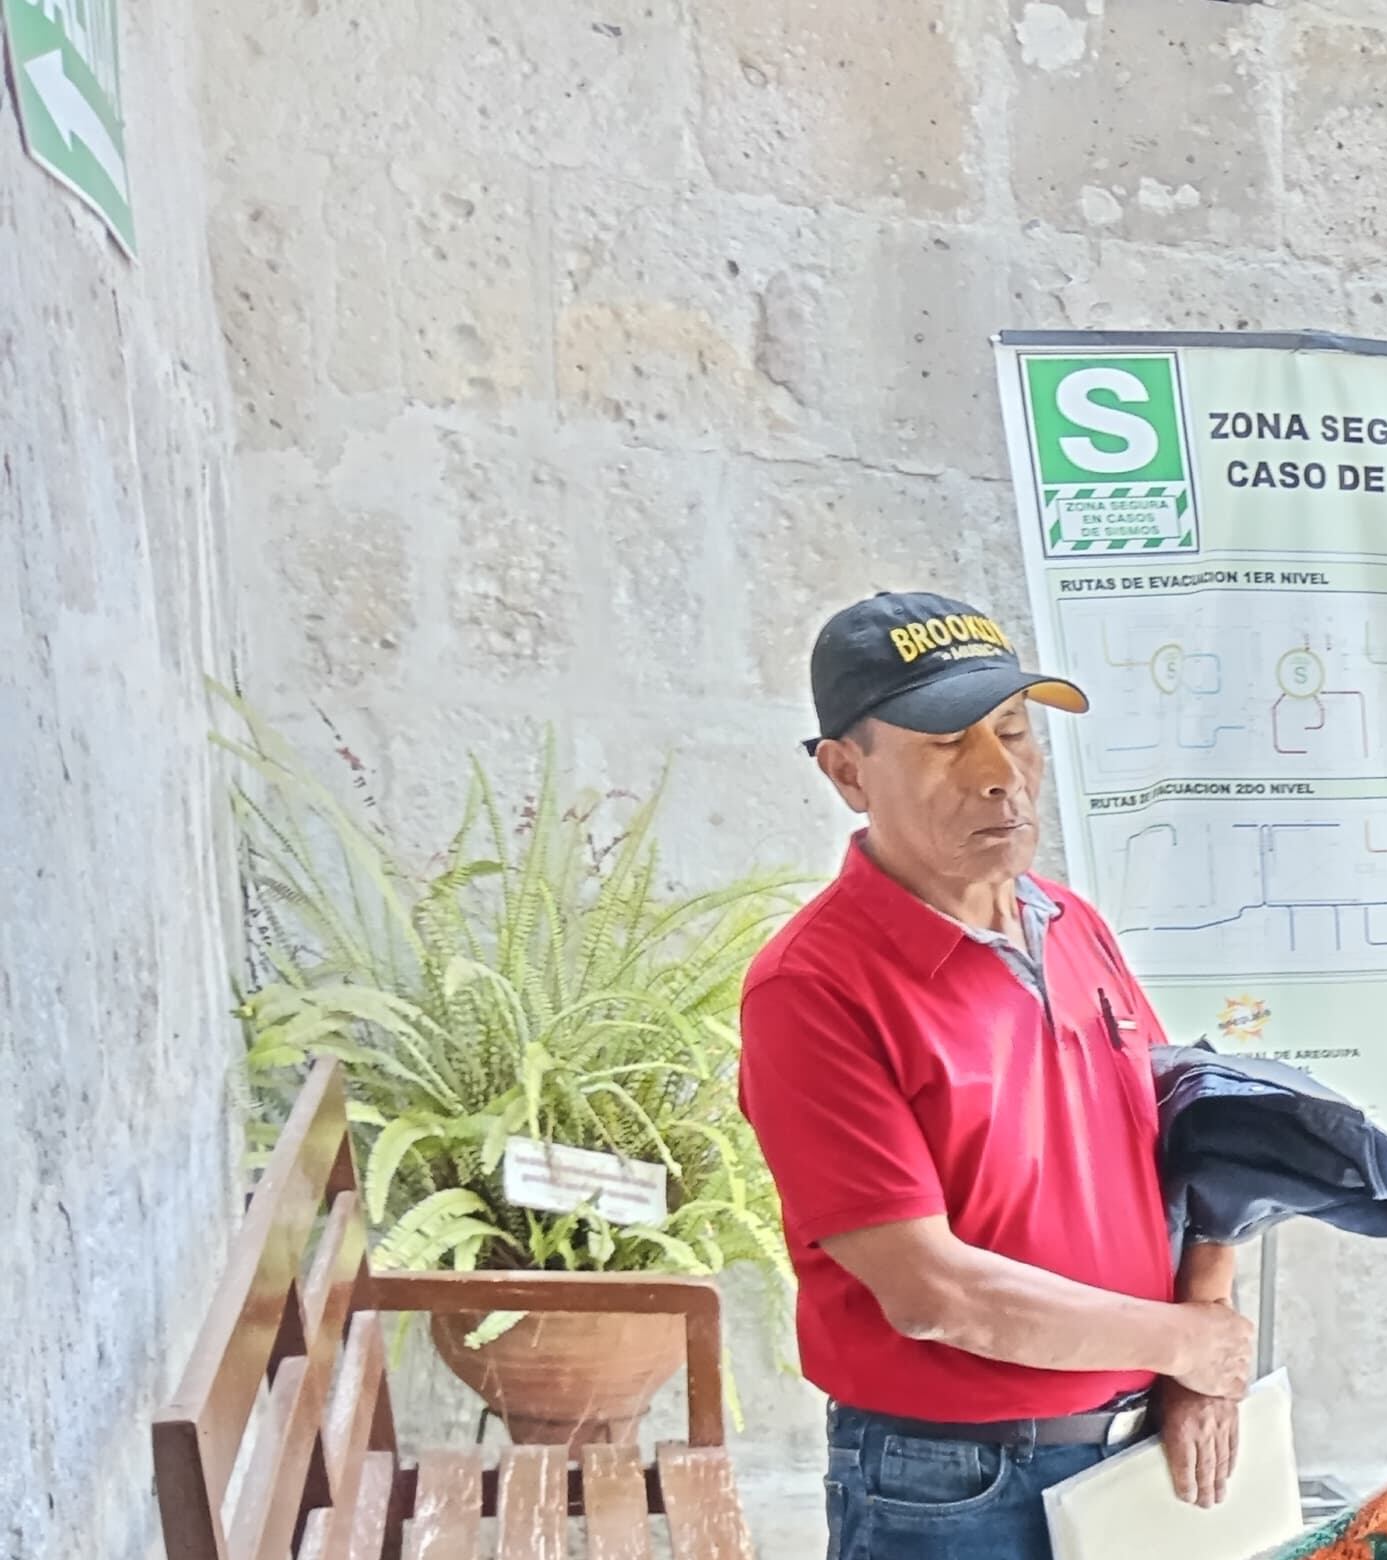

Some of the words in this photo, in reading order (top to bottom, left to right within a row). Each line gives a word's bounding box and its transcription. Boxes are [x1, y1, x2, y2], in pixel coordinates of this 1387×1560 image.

[1055, 367, 1160, 474] S
[1208, 412, 1310, 440] ZONA
[1227, 459, 1327, 489] CASO
[1337, 464, 1385, 493] DE
[1065, 501, 1106, 513] ZONA
[1109, 499, 1170, 512] SEGURA
[1082, 513, 1102, 525] EN
[1106, 512, 1156, 525] CASOS
[1080, 526, 1101, 538] DE
[1104, 525, 1160, 538] SISMOS
[1060, 578, 1117, 592] RUTAS
[1121, 576, 1145, 590] DE
[1243, 571, 1276, 584] 1ER
[1280, 571, 1330, 585] NIVEL
[1089, 795, 1138, 810] RUTAS
[1235, 783, 1266, 796] 2DO
[1269, 783, 1316, 795] NIVEL
[1273, 1049, 1291, 1060] DE
[1294, 1048, 1361, 1060] AREQUIPA
